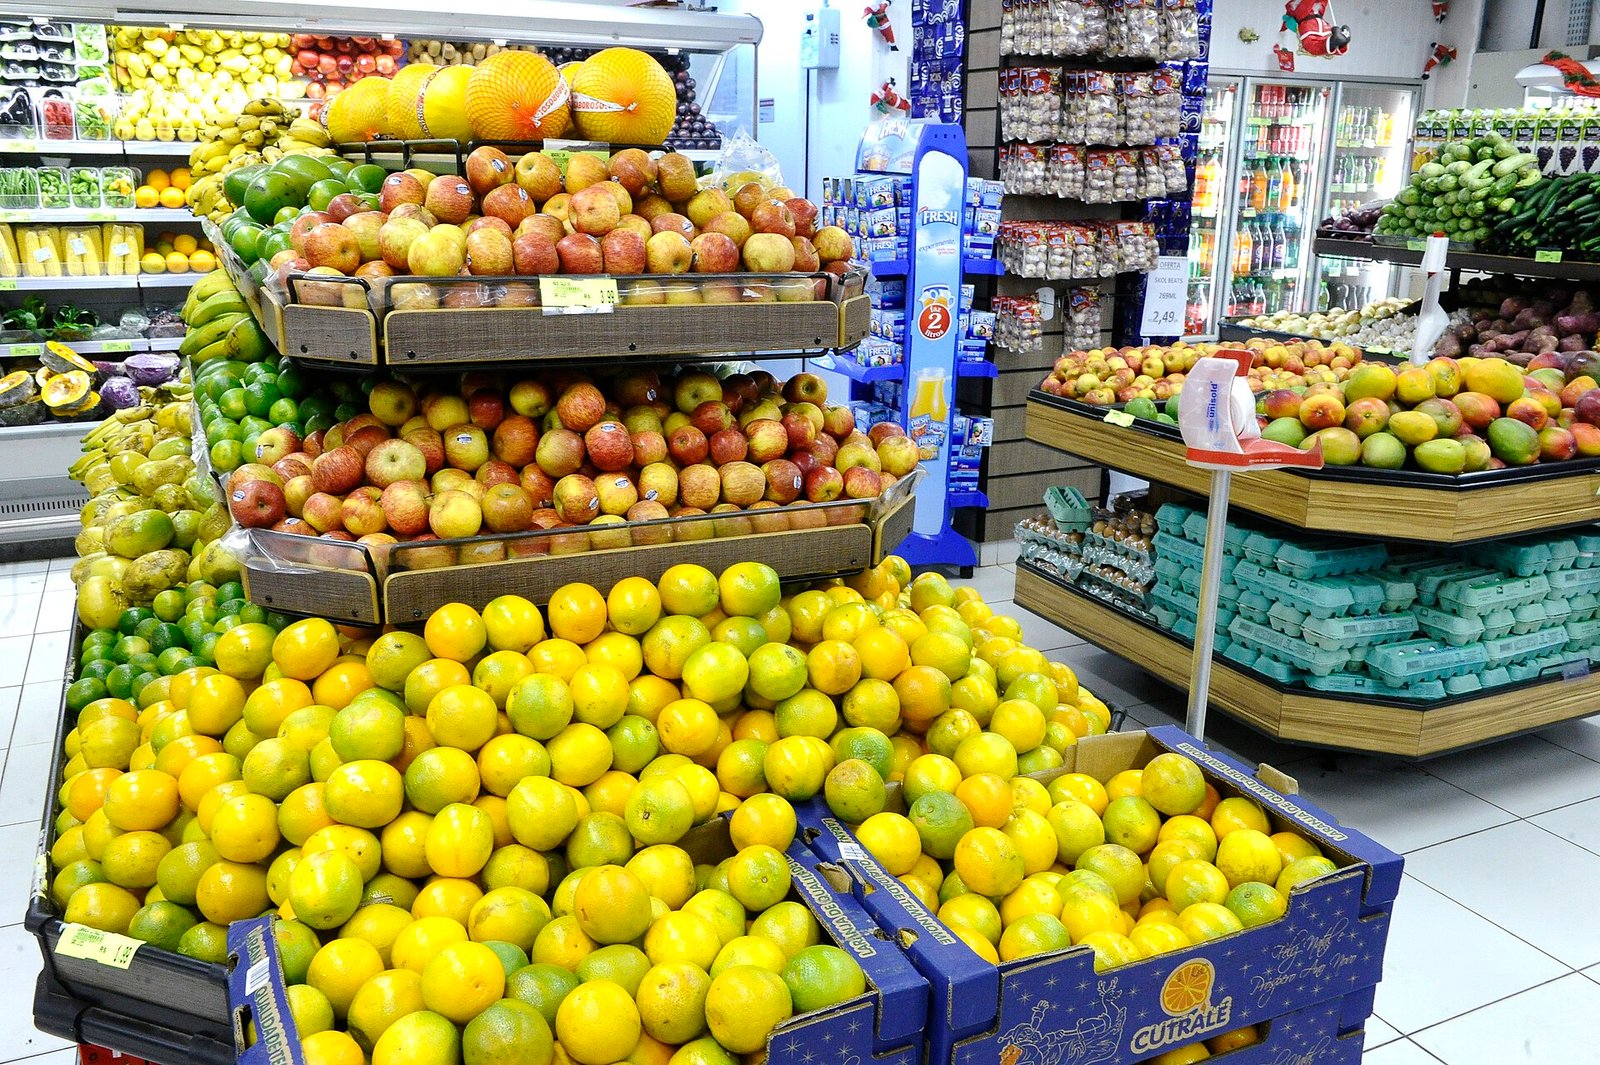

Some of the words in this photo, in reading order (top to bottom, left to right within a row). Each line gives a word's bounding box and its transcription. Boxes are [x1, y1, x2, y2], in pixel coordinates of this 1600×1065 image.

[868, 183, 893, 197] FRESH
[870, 211, 895, 225] FRESH
[922, 209, 959, 226] FRESH
[977, 212, 1000, 223] FRESH
[871, 241, 896, 251] FRESH
[1159, 261, 1181, 269] OFERTA
[929, 304, 942, 313] faz
[927, 313, 943, 330] 2
[973, 315, 995, 326] FRESH
[1152, 310, 1175, 324] 2,49
[924, 329, 945, 338] litros
[867, 346, 892, 358] FRESH
[1209, 383, 1218, 418] unisold
[1179, 743, 1210, 764] NOME
[1208, 759, 1231, 776] TEM
[1230, 769, 1283, 805] QUALIDADE
[1281, 802, 1297, 814] DE
[1299, 812, 1348, 841] LARANJA
[824, 903, 842, 918] DE
[902, 899, 924, 919] TEM
[920, 918, 954, 946] NOME
[255, 984, 284, 1055] QUALIDADE
